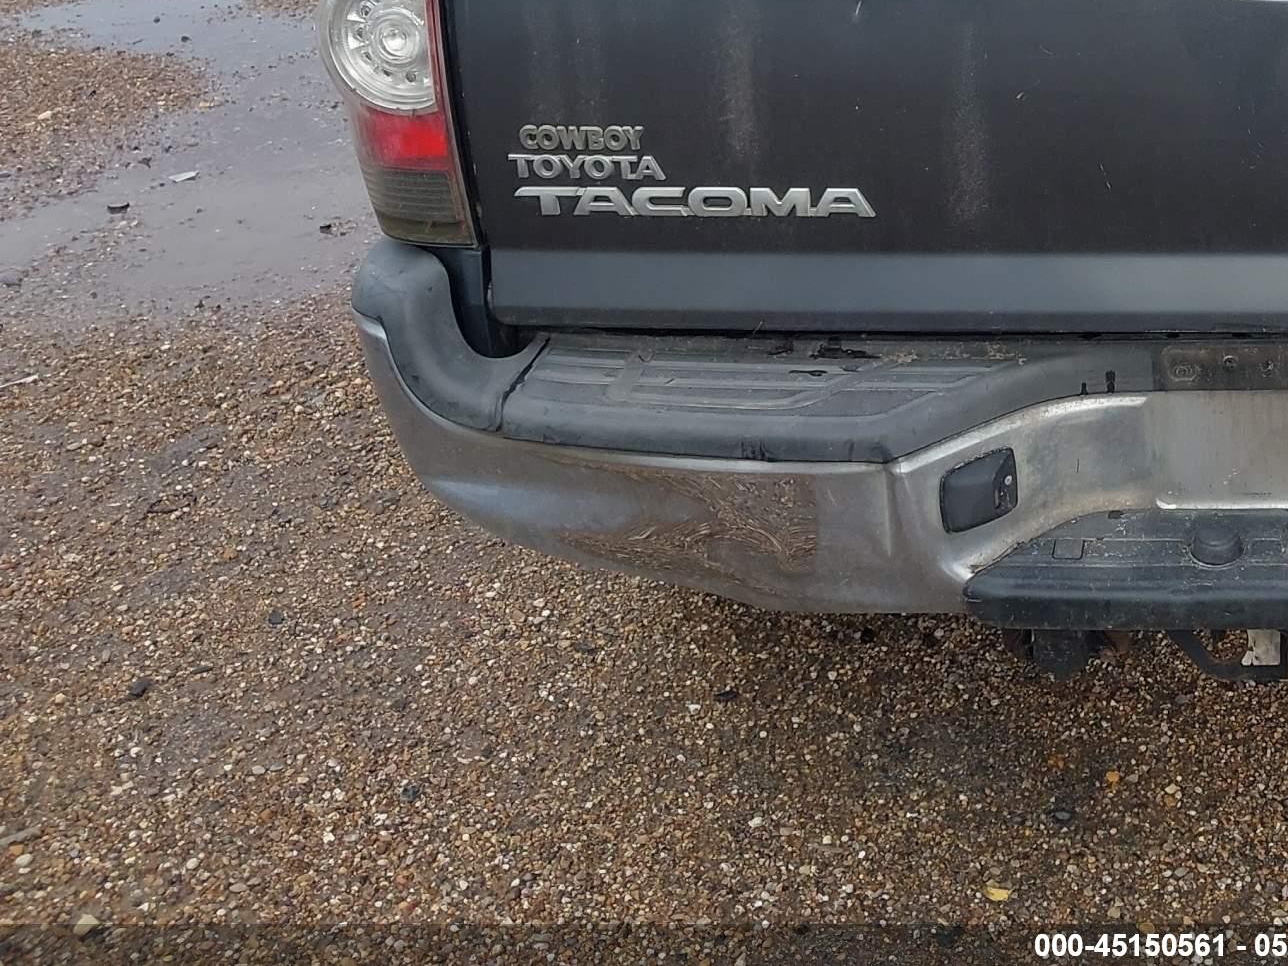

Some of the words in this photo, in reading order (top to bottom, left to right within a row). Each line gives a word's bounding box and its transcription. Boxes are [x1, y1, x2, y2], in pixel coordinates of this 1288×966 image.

[519, 125, 644, 151] COWBOY
[507, 153, 667, 181] TOYOTA
[514, 186, 877, 218] TACOMA
